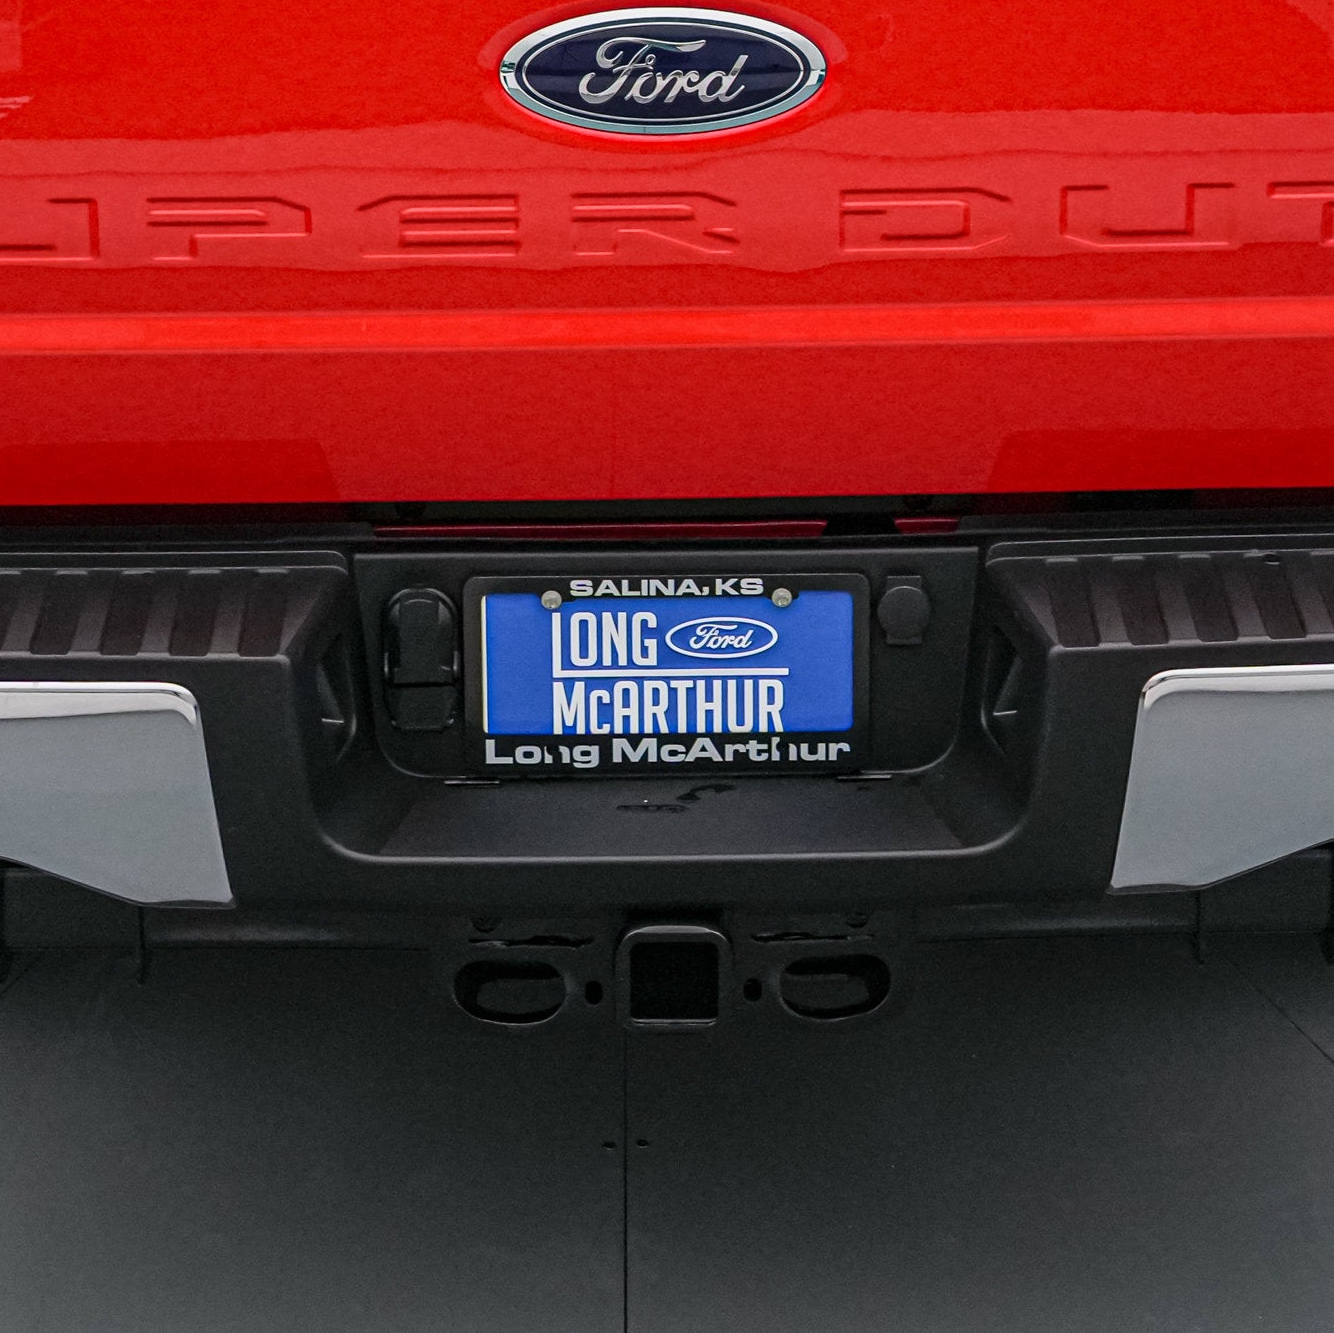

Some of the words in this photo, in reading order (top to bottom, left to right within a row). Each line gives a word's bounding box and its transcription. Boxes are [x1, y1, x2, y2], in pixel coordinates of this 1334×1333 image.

[578, 36, 746, 104] Ford
[569, 579, 710, 597] SALINA,
[715, 578, 764, 596] KS
[552, 611, 658, 677] LONG
[689, 623, 753, 650] Ford
[553, 679, 784, 735] McARTHUR
[485, 739, 599, 768] Long
[612, 737, 850, 764] McArthur
